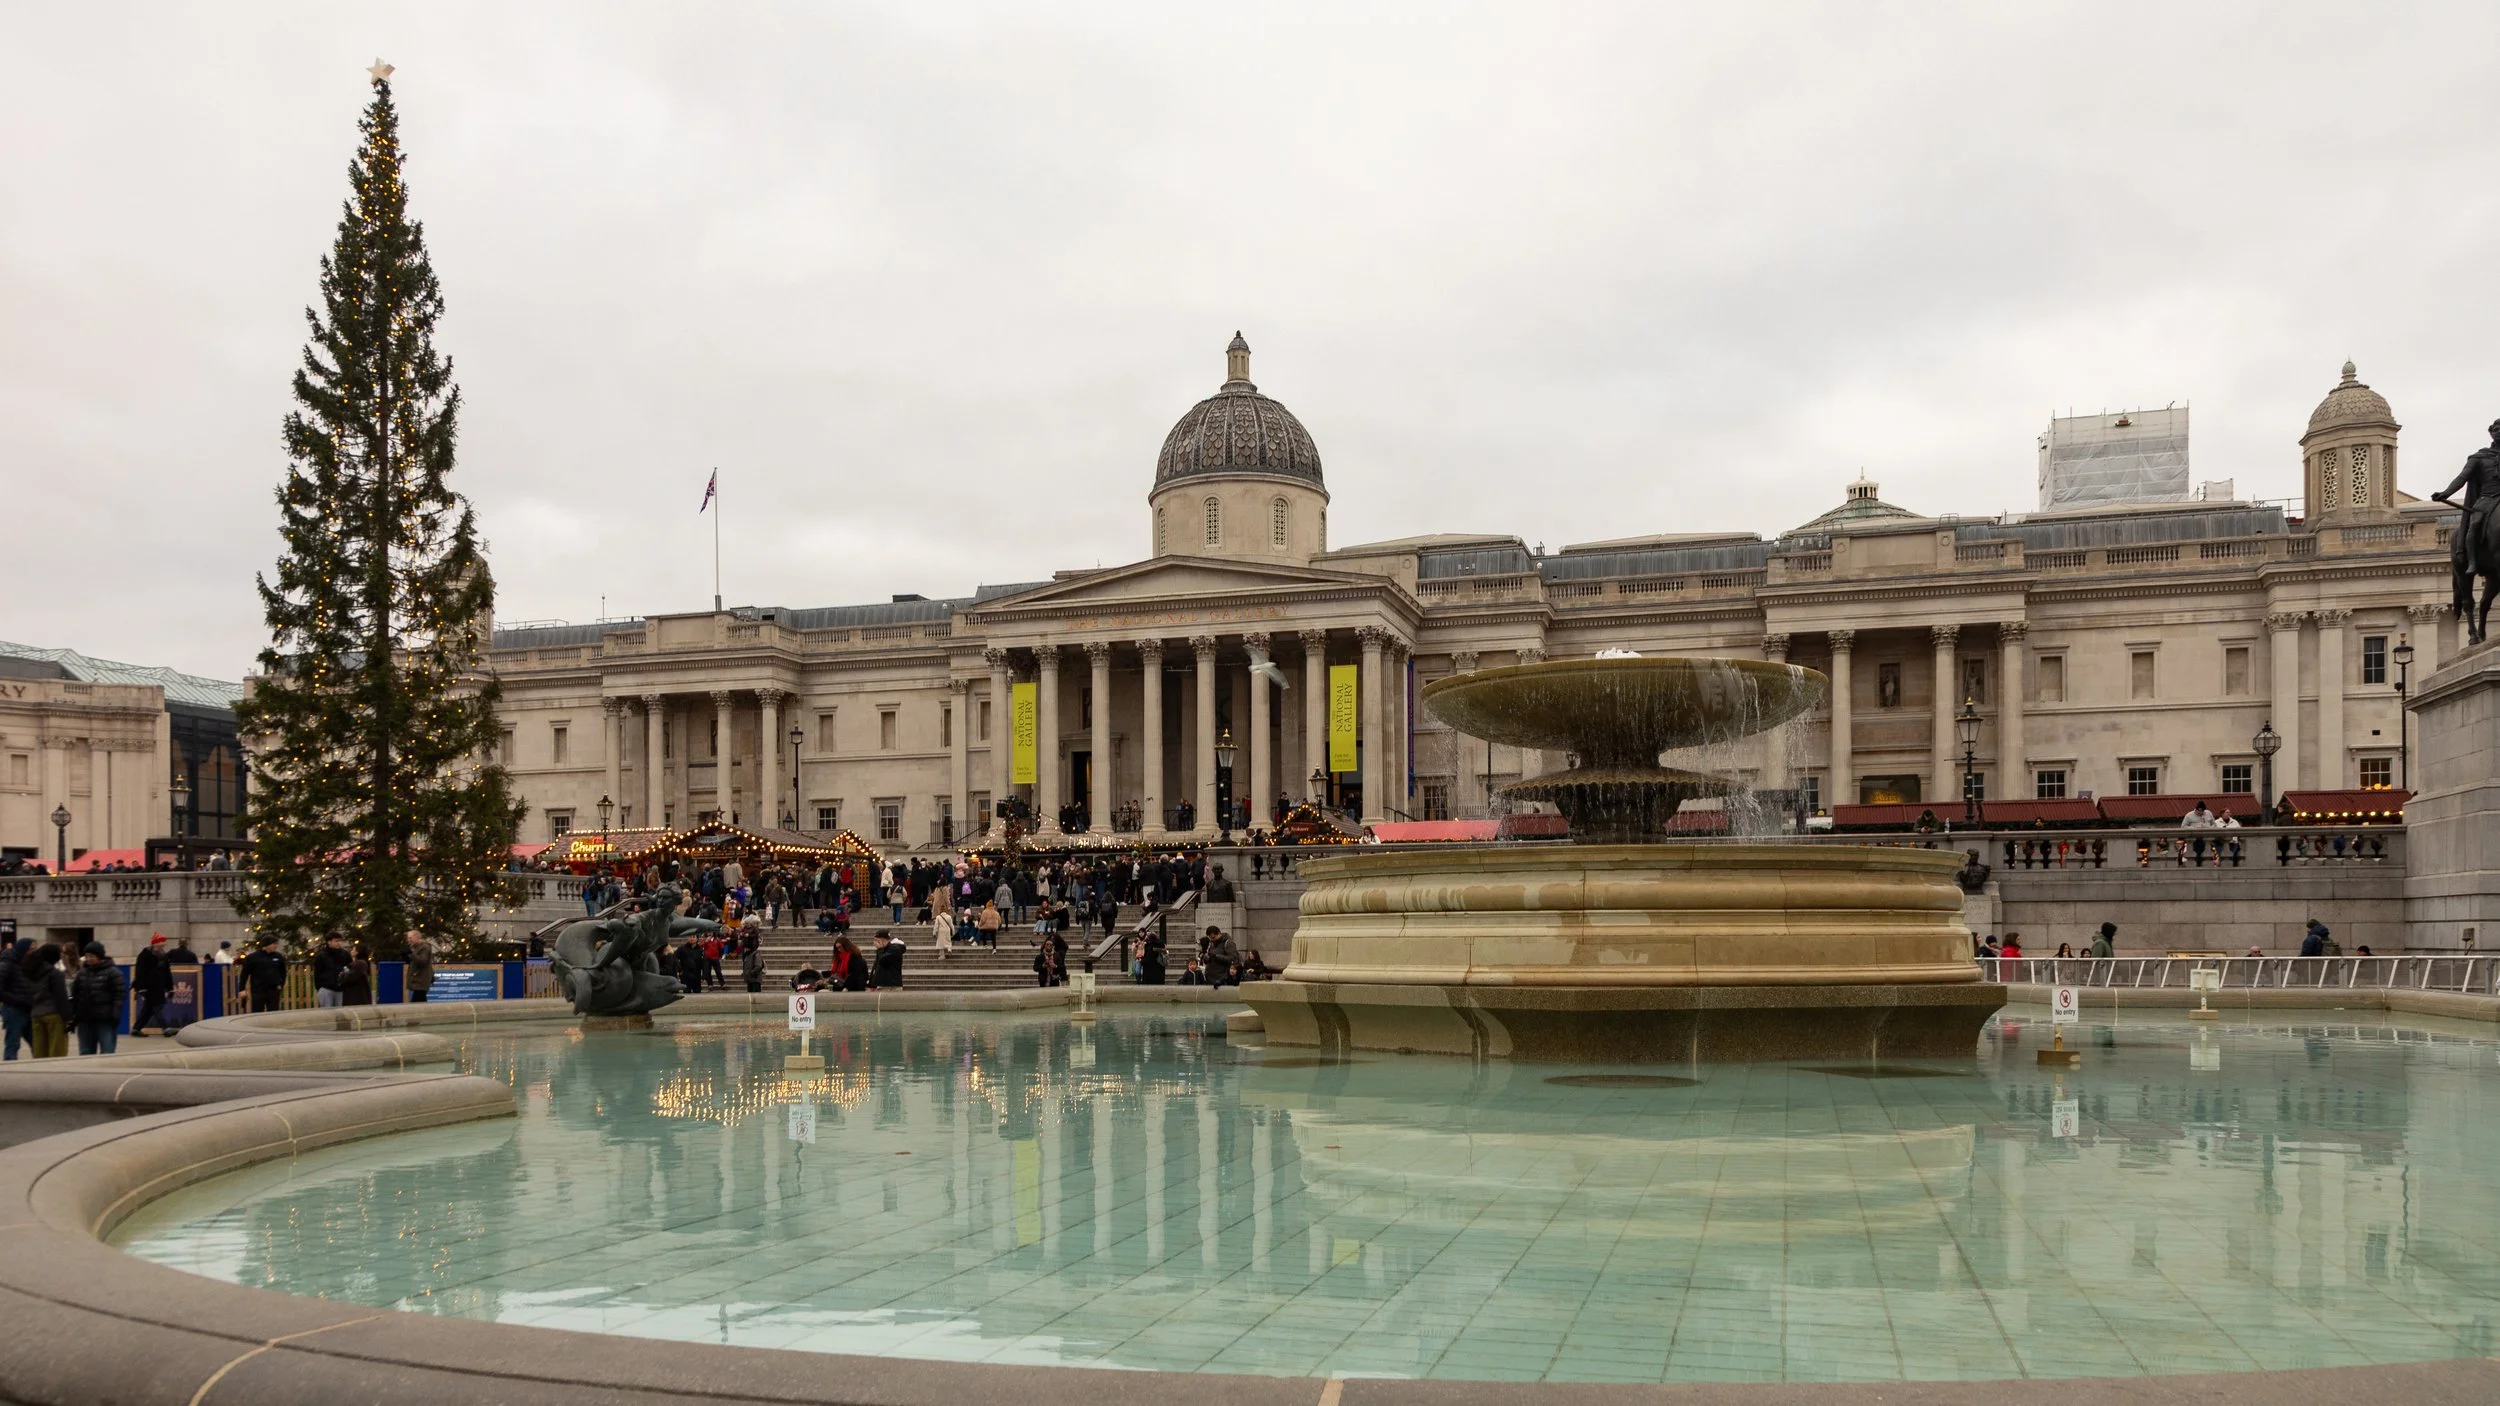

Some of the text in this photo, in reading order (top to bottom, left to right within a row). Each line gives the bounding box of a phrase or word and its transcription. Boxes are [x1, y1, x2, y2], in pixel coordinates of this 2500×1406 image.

[1066, 605, 1290, 631] THE NATIONAL GALLERY
[1344, 683, 1352, 732] GALLERY
